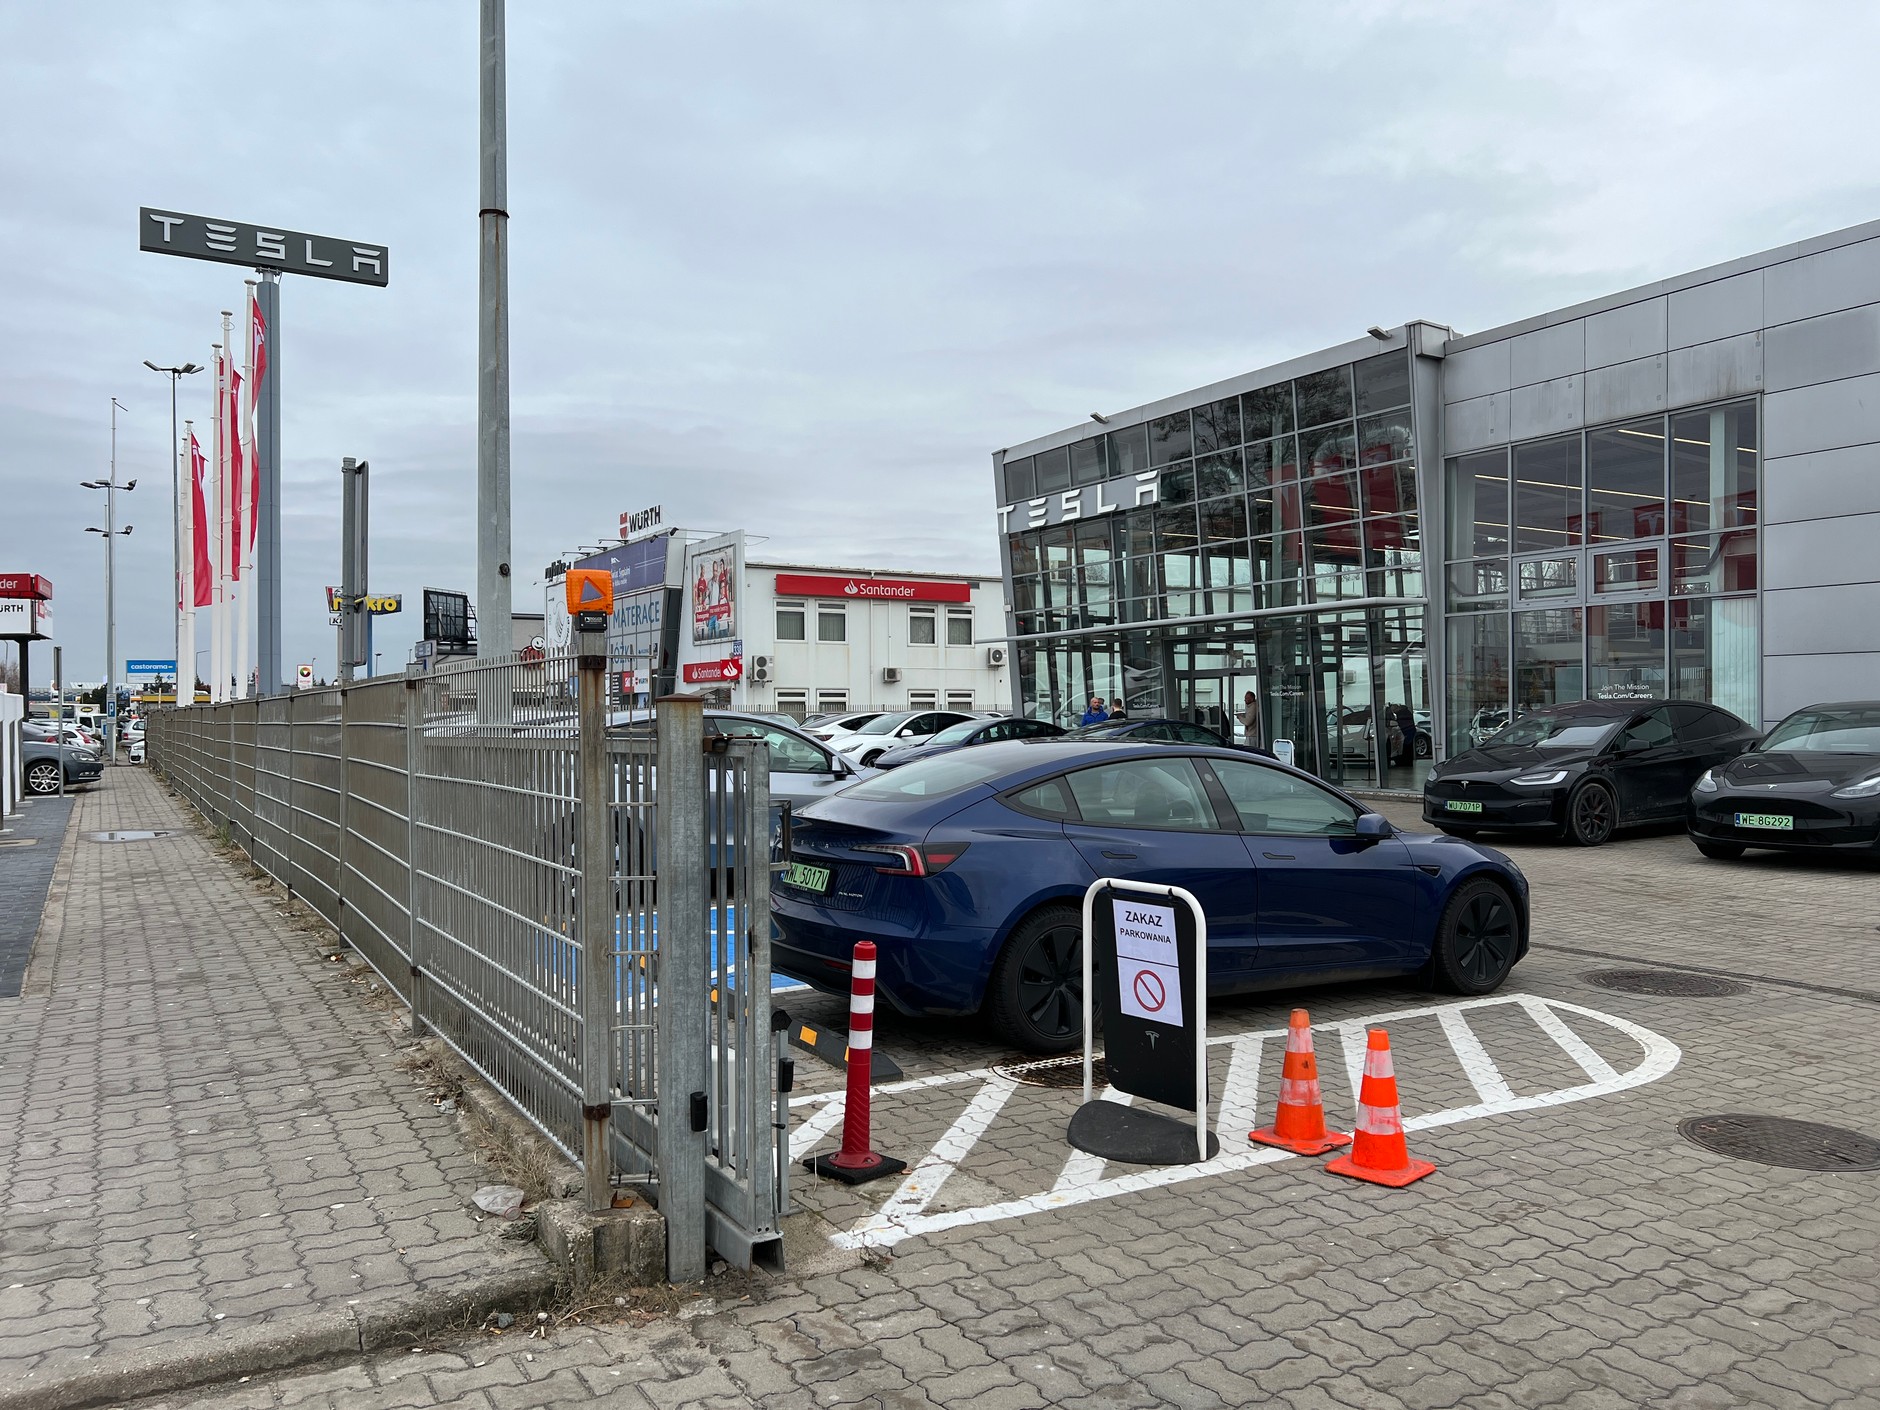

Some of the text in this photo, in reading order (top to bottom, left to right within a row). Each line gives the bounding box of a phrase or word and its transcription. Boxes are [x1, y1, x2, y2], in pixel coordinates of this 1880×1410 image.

[150, 214, 381, 275] TESLA
[996, 470, 1158, 534] TESLA
[629, 505, 660, 532] WÜRTH
[860, 583, 915, 596] Santander
[613, 601, 660, 629] MATERACE
[1597, 692, 1653, 700] Tesla.Com/Careers
[1741, 815, 1790, 827] WE 8G292
[800, 867, 829, 890] 5017V
[1125, 910, 1163, 927] ZAKAZ
[1119, 927, 1172, 944] PARKOWANIA
